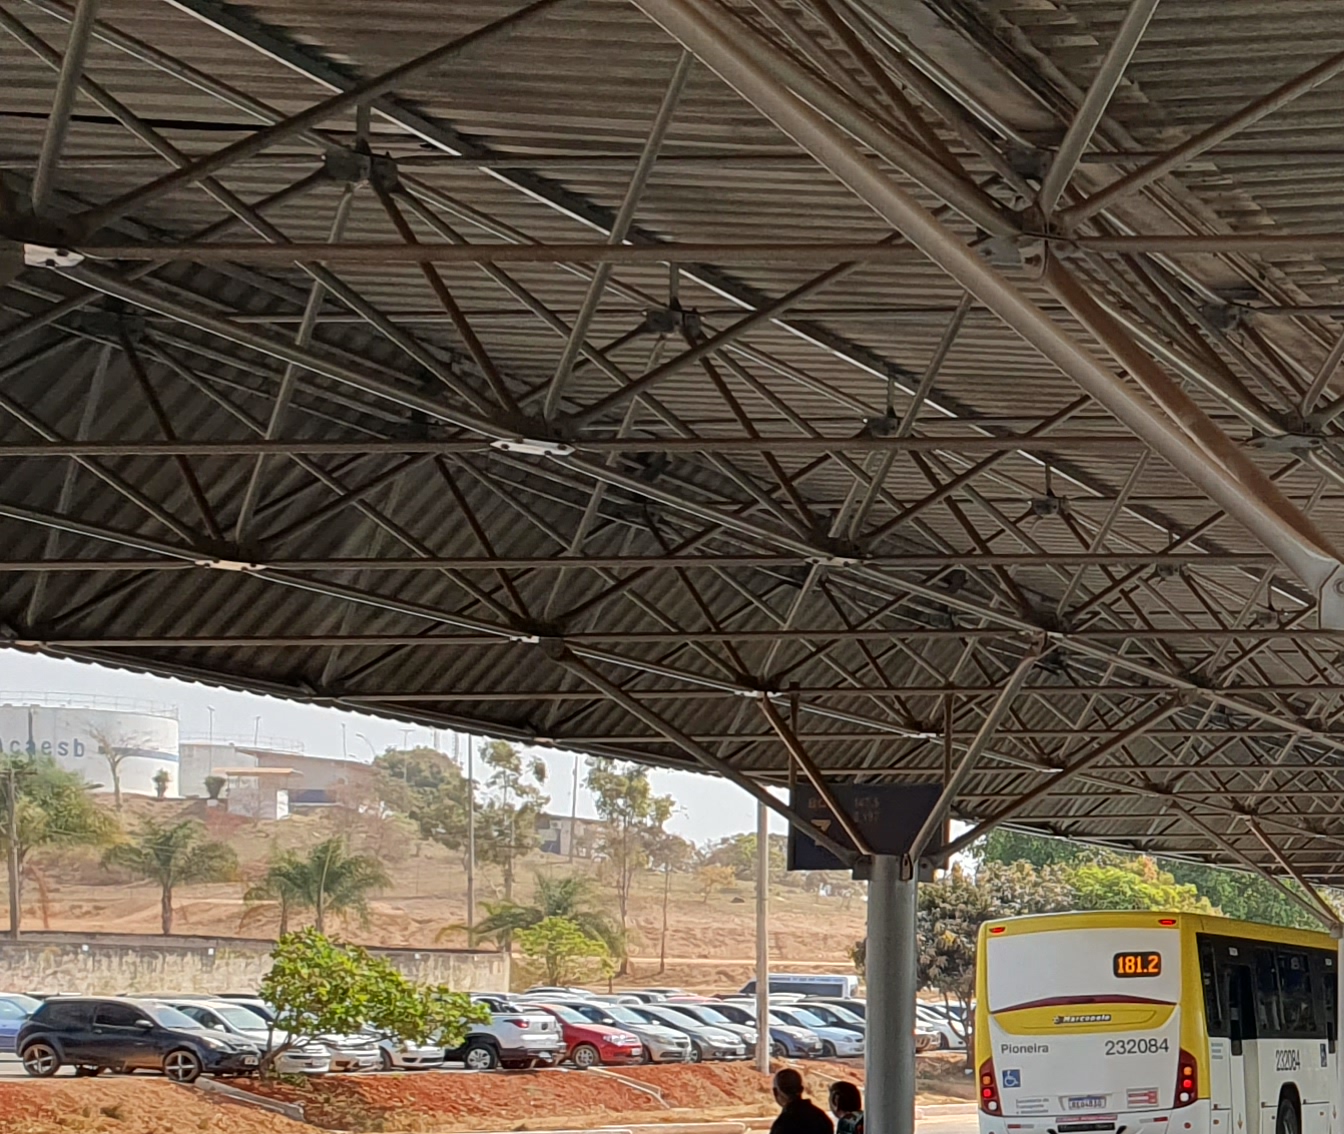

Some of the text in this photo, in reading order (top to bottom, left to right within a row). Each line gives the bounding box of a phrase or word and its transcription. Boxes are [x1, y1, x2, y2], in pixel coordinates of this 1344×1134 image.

[1117, 955, 1159, 974] 181.2
[1001, 1038, 1170, 1056] Pioneira 232084
